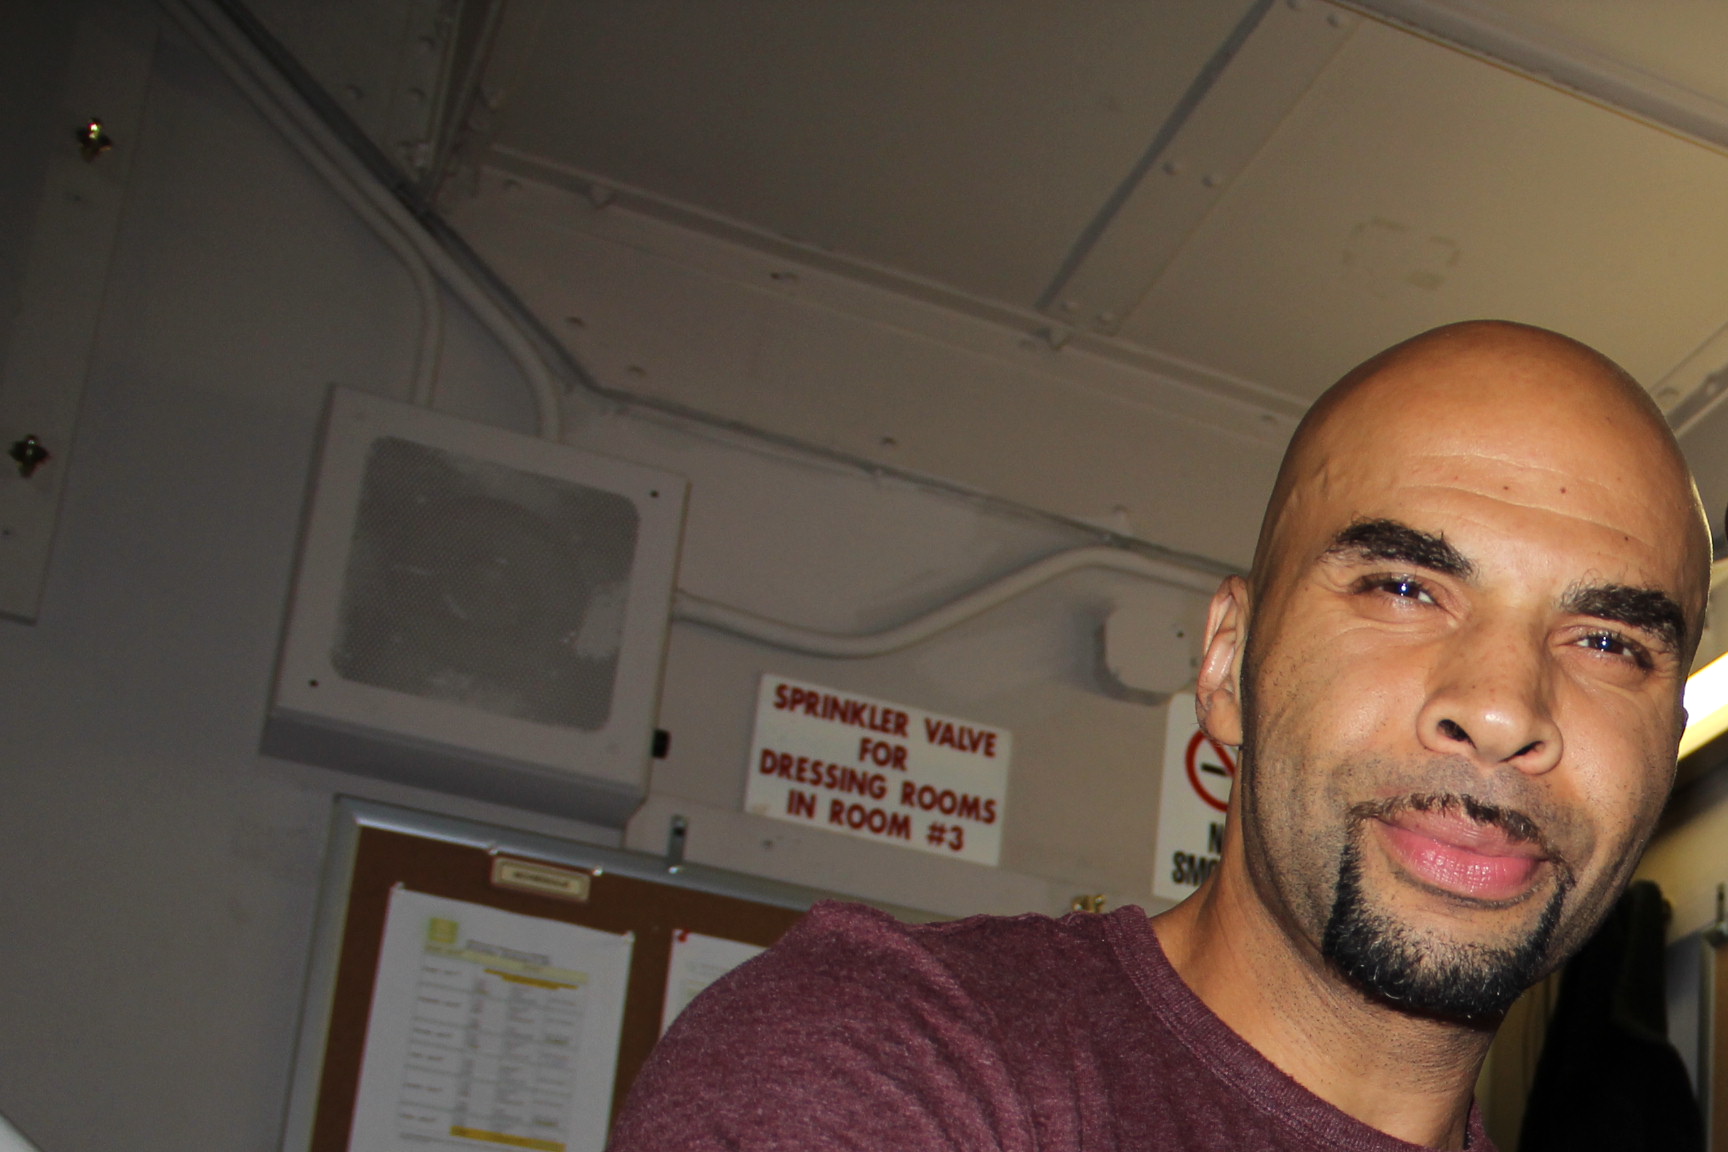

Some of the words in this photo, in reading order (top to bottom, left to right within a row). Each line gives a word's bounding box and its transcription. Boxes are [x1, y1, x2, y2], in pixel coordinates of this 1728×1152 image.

[773, 683, 909, 738] SPRINKLER
[924, 717, 997, 758] VALVE
[858, 737, 908, 771] FOR
[759, 748, 888, 800] DRESSING
[900, 780, 997, 825] ROOMS
[787, 789, 817, 819] IN
[829, 799, 912, 840] ROOM
[927, 822, 964, 852] #3
